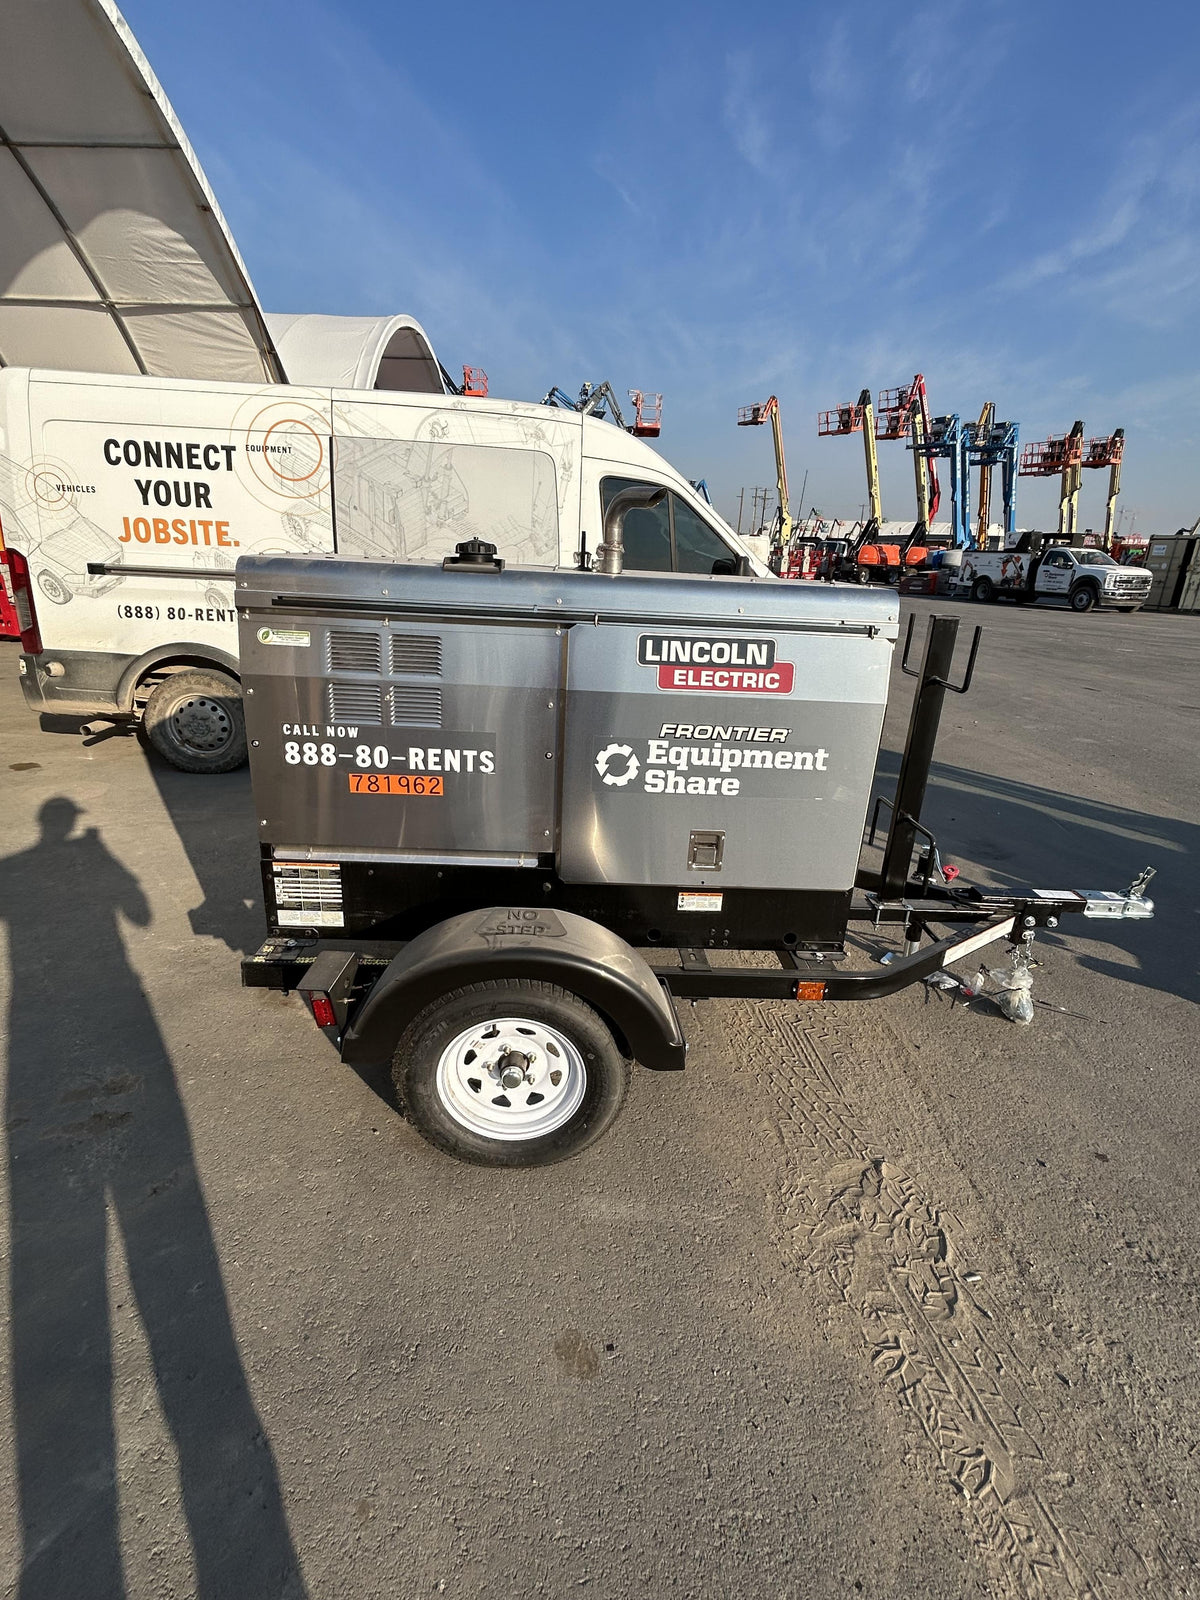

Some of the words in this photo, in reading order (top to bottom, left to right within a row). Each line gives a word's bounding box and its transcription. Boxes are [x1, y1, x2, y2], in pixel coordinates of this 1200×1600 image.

[103, 438, 236, 471] CONNECT
[245, 444, 292, 454] EQUIPMENT
[55, 484, 96, 493] VEHICLES
[134, 479, 213, 508] YOUR
[118, 516, 240, 547] JOBSITE.
[117, 605, 160, 620] (888)
[167, 607, 236, 622] 80-RENT
[645, 639, 768, 666] LINCOLN
[673, 669, 780, 689] ELECTRIC
[282, 724, 320, 737] CALL
[326, 726, 359, 738] NOW
[659, 723, 790, 743] FRONTIER
[284, 741, 495, 773] 888-80-RENTS
[646, 740, 830, 773] Equipment
[351, 775, 441, 794] 781962
[643, 769, 741, 796] Share
[507, 910, 538, 920] NO
[496, 924, 545, 935] STEP
